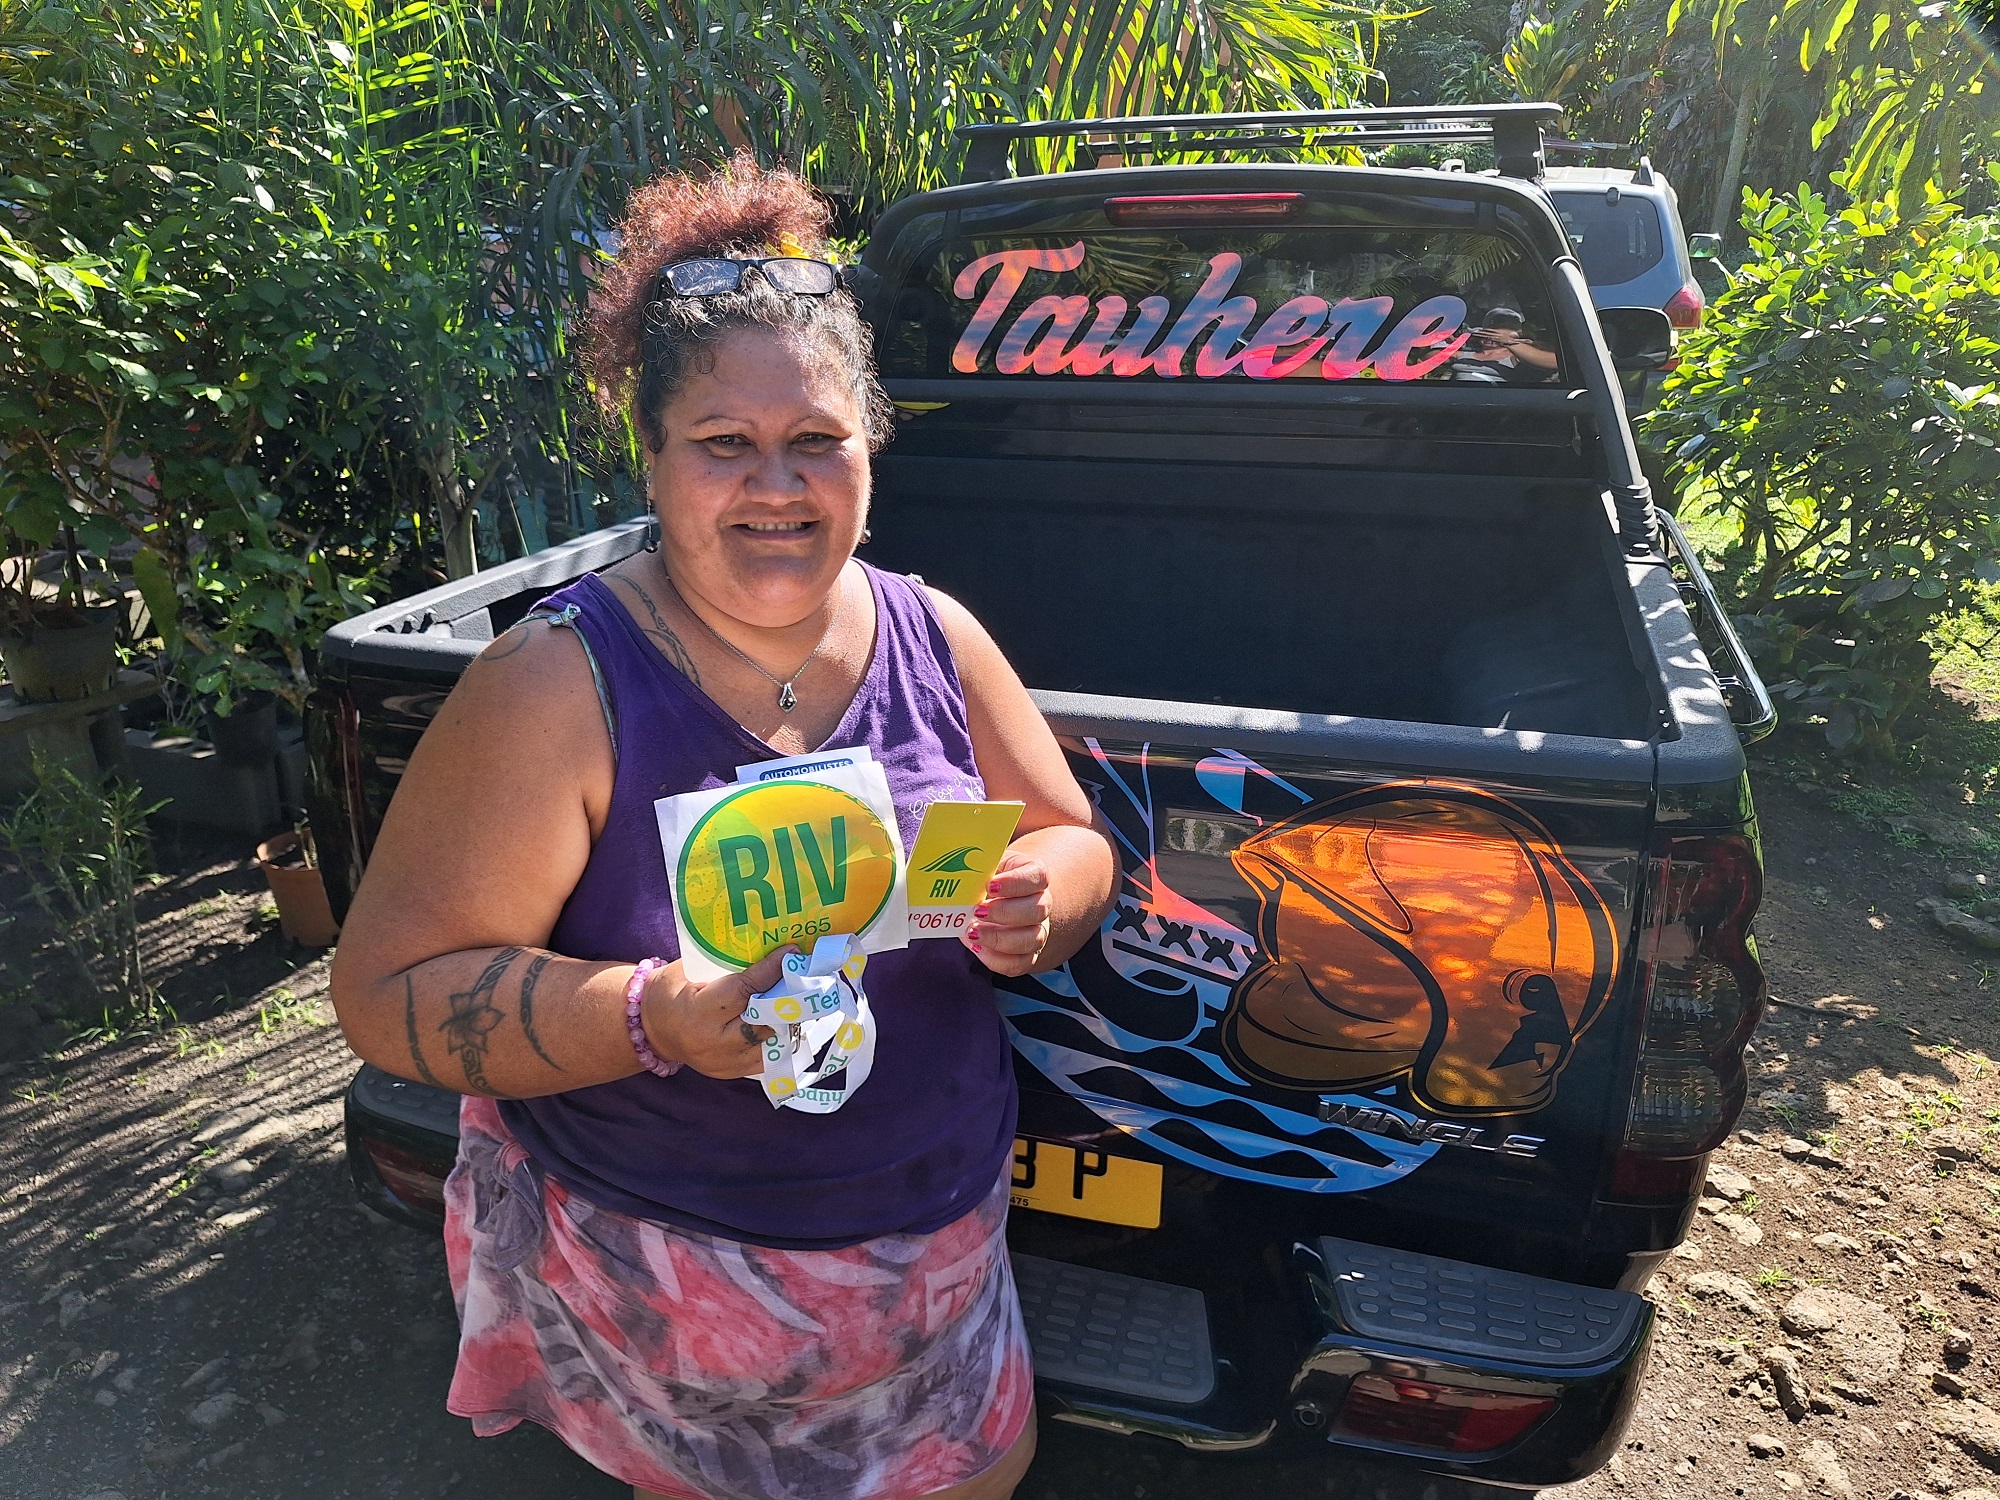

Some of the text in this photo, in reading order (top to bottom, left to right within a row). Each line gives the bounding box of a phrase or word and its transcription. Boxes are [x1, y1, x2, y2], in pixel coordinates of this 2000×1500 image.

[951, 241, 1471, 382] Tauhere
[763, 759, 851, 781] AUTOMOBILISTES
[718, 815, 849, 927] RIV
[929, 879, 961, 898] RIV
[762, 916, 832, 947] N°265
[908, 912, 967, 929] °0616
[1318, 1100, 1546, 1158] WINGLE
[1073, 1148, 1108, 1199] P
